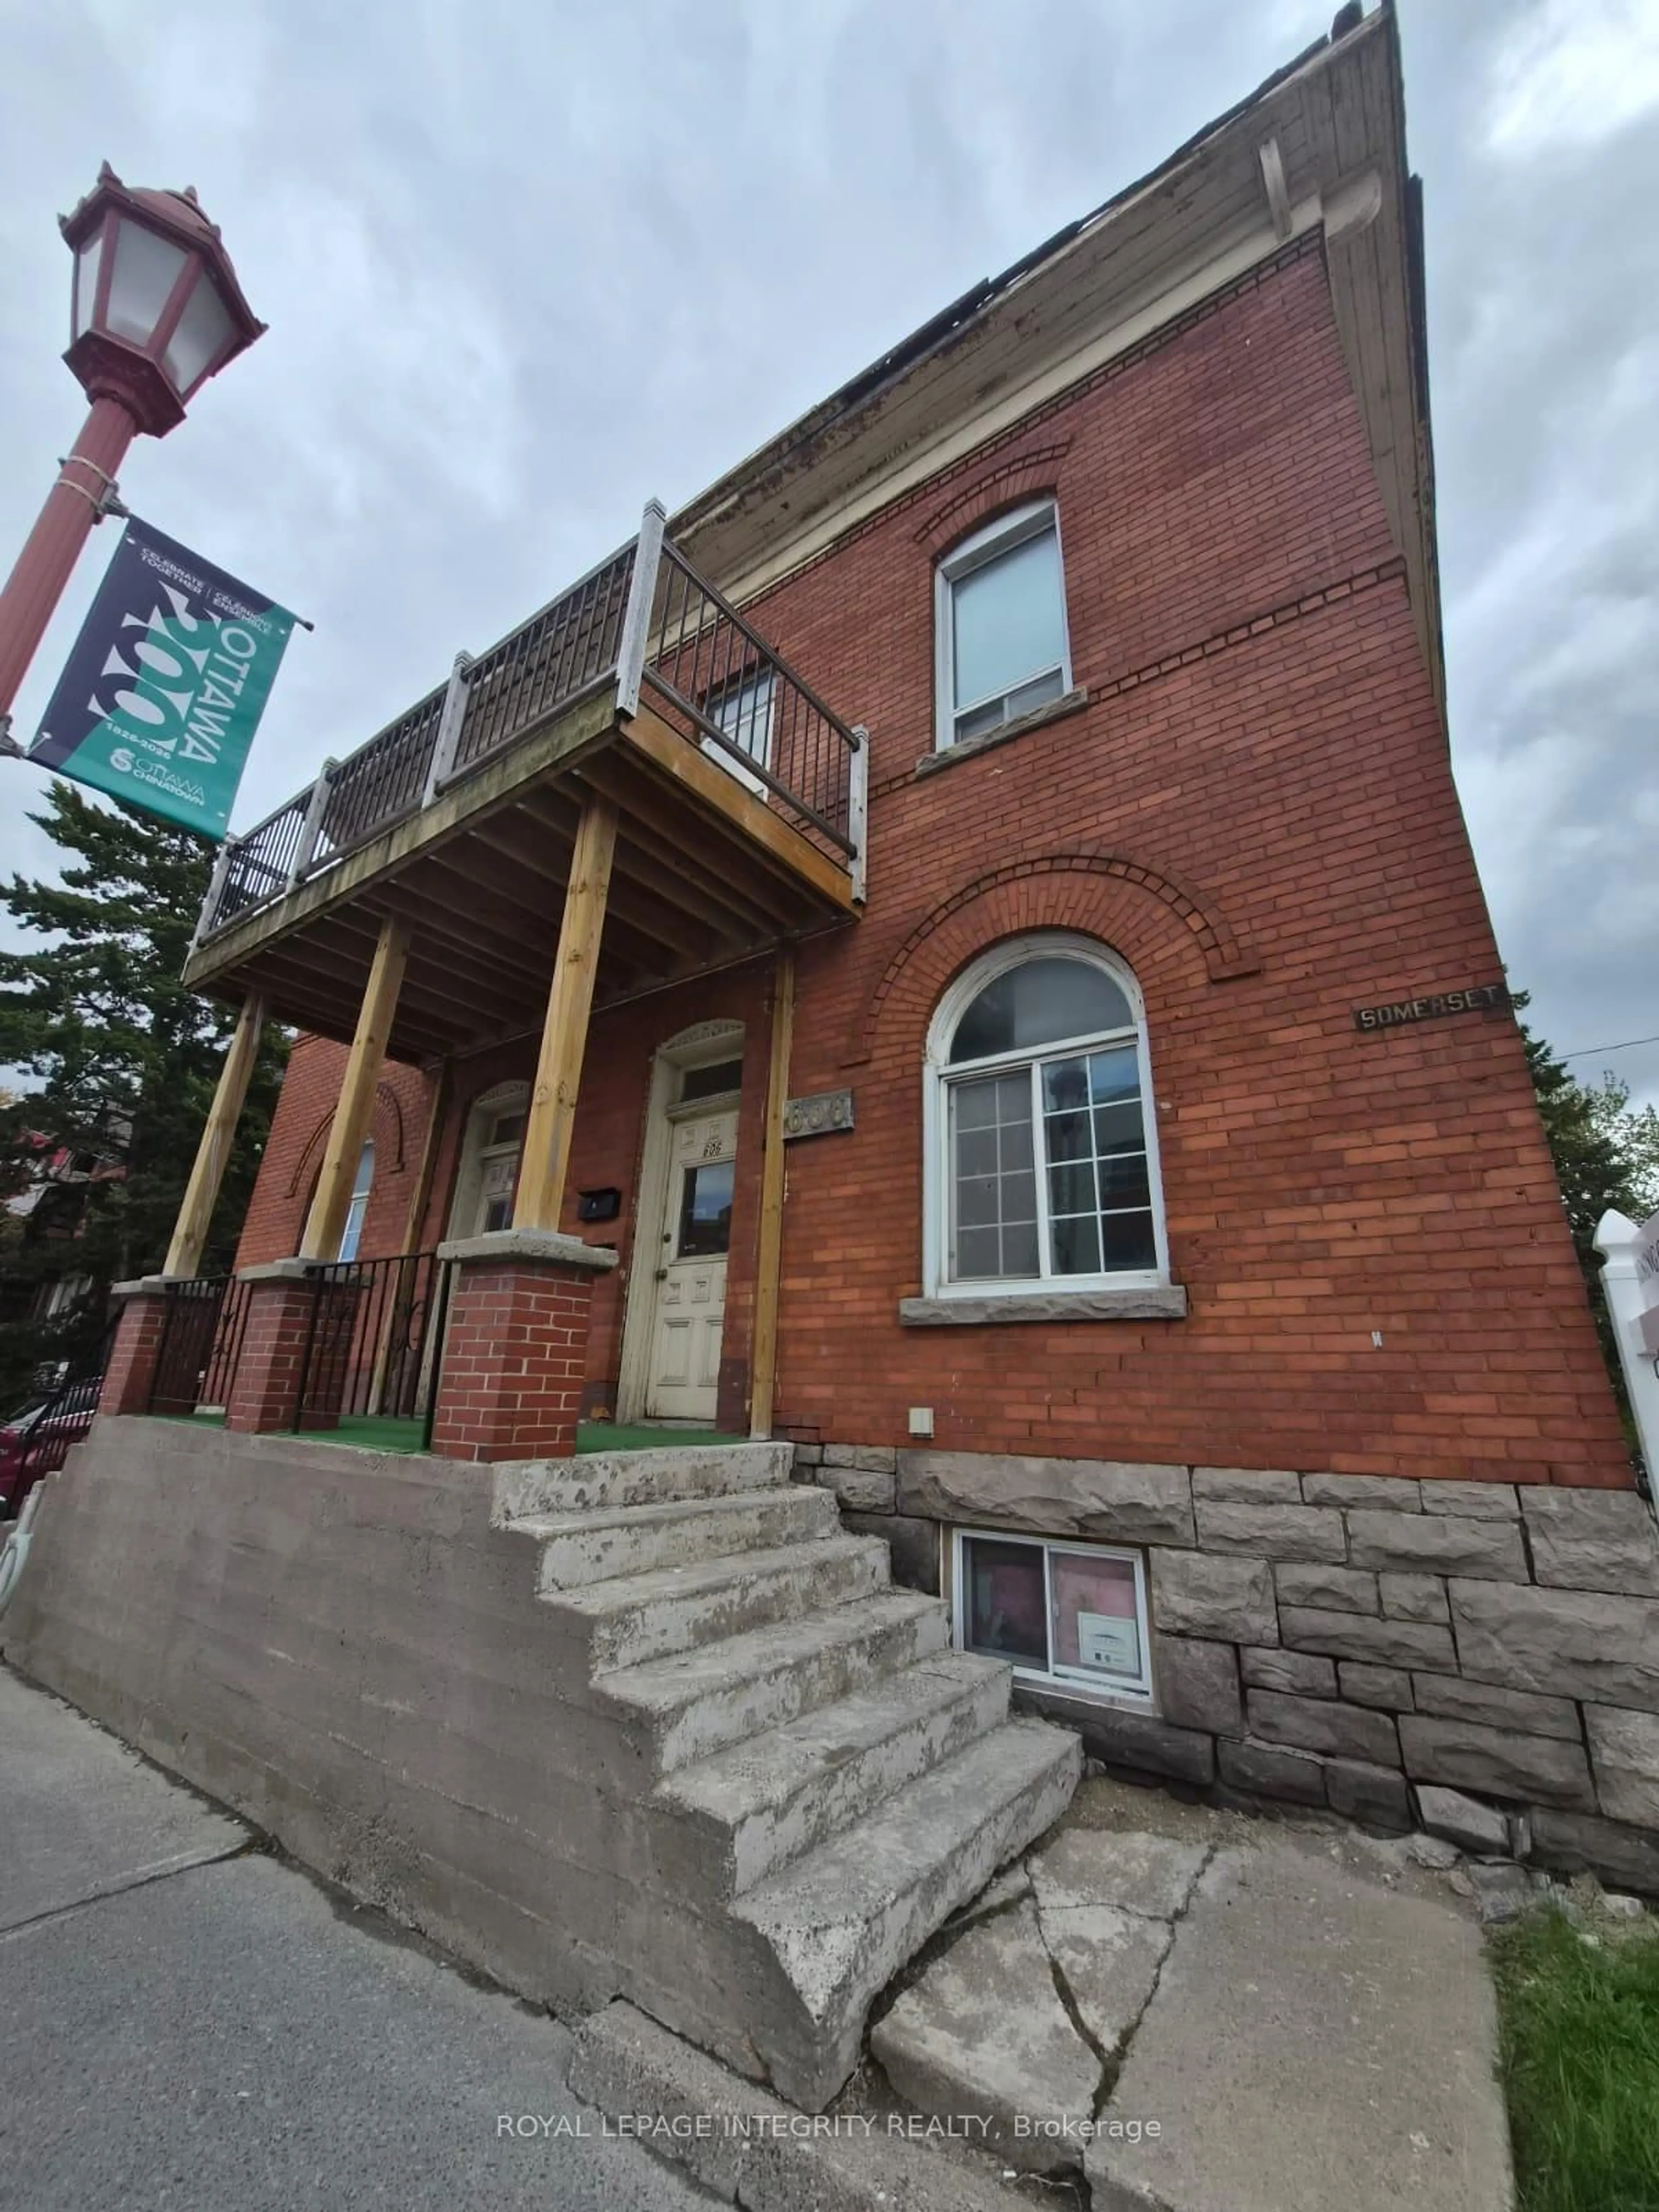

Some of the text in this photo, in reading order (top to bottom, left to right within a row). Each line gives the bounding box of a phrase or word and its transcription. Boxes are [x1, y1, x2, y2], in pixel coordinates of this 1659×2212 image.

[178, 627, 257, 764] OTTAWA
[133, 769, 205, 806] CHINATOWN
[136, 758, 205, 802] OTTAWA
[1360, 986, 1498, 1028] SOMERSET
